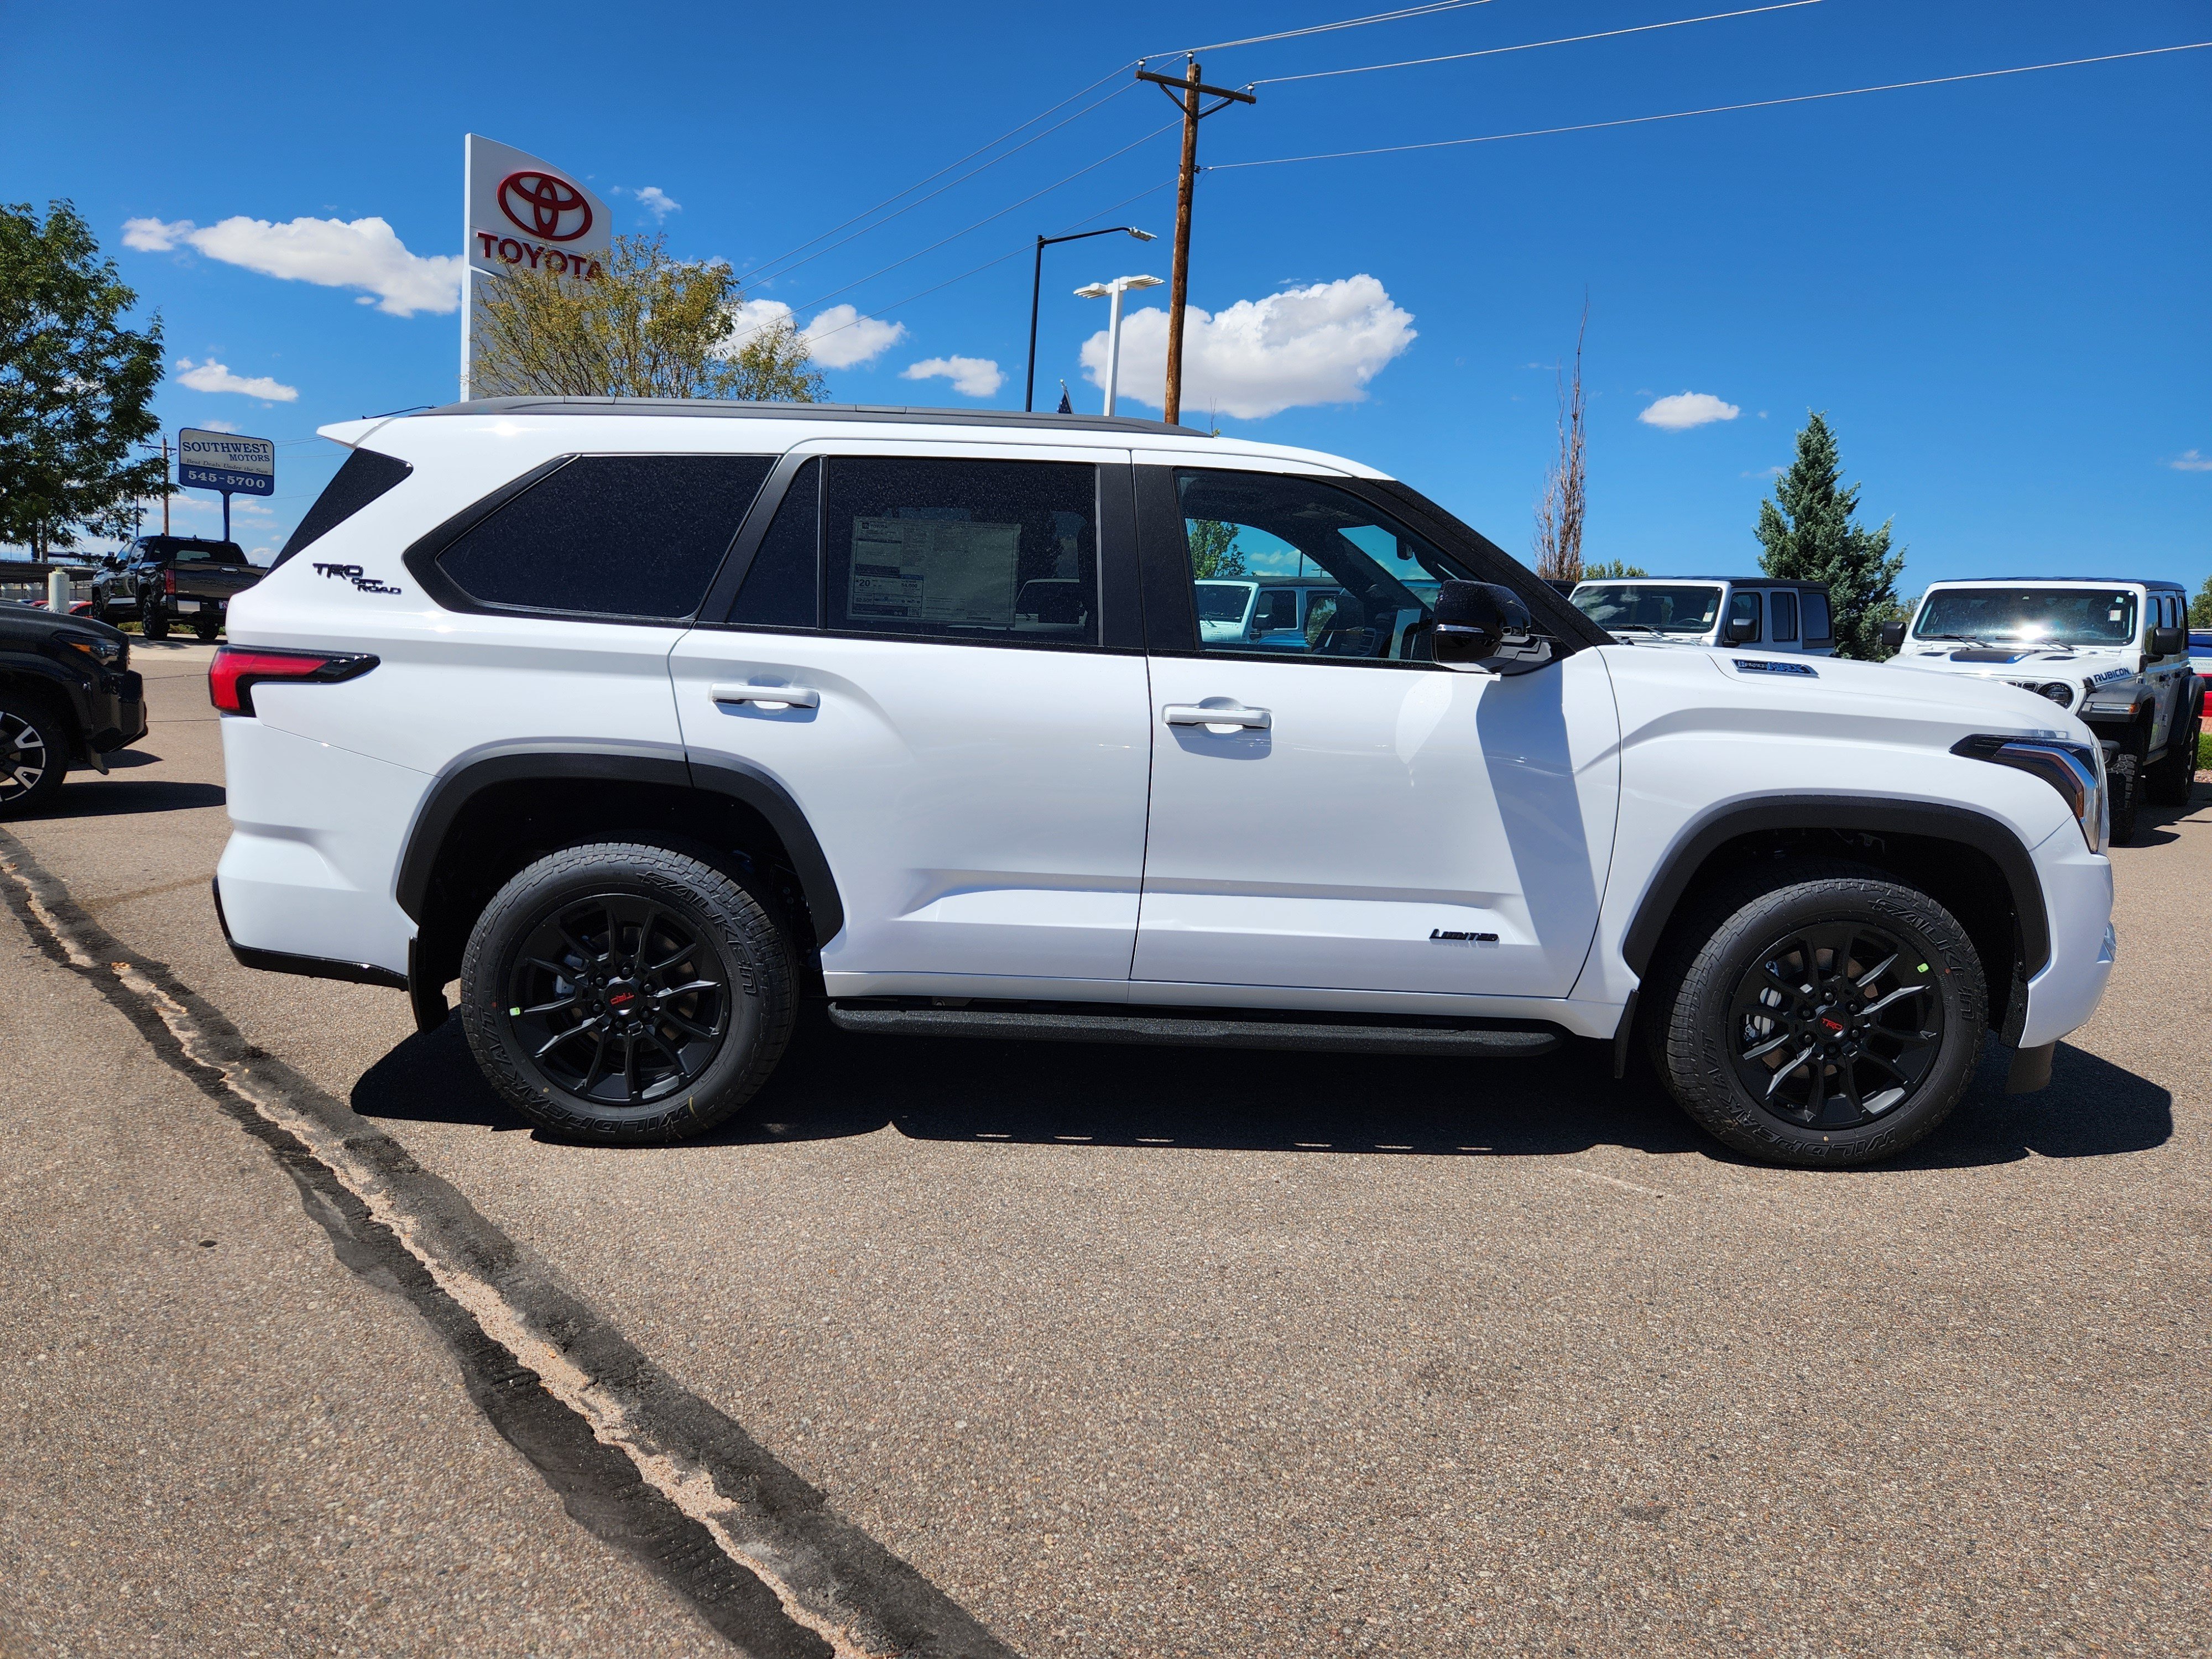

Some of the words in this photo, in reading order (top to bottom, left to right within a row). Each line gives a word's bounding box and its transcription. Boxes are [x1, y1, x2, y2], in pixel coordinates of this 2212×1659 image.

[182, 442, 268, 453] SOUTHWEST
[229, 453, 270, 462] MOTORS
[188, 470, 266, 488] 545-5700
[312, 563, 364, 580] TRD
[357, 584, 402, 595] ROAD
[2093, 667, 2130, 682] RUBICON
[610, 992, 634, 1005] TRD
[1822, 1018, 1843, 1031] TRD
